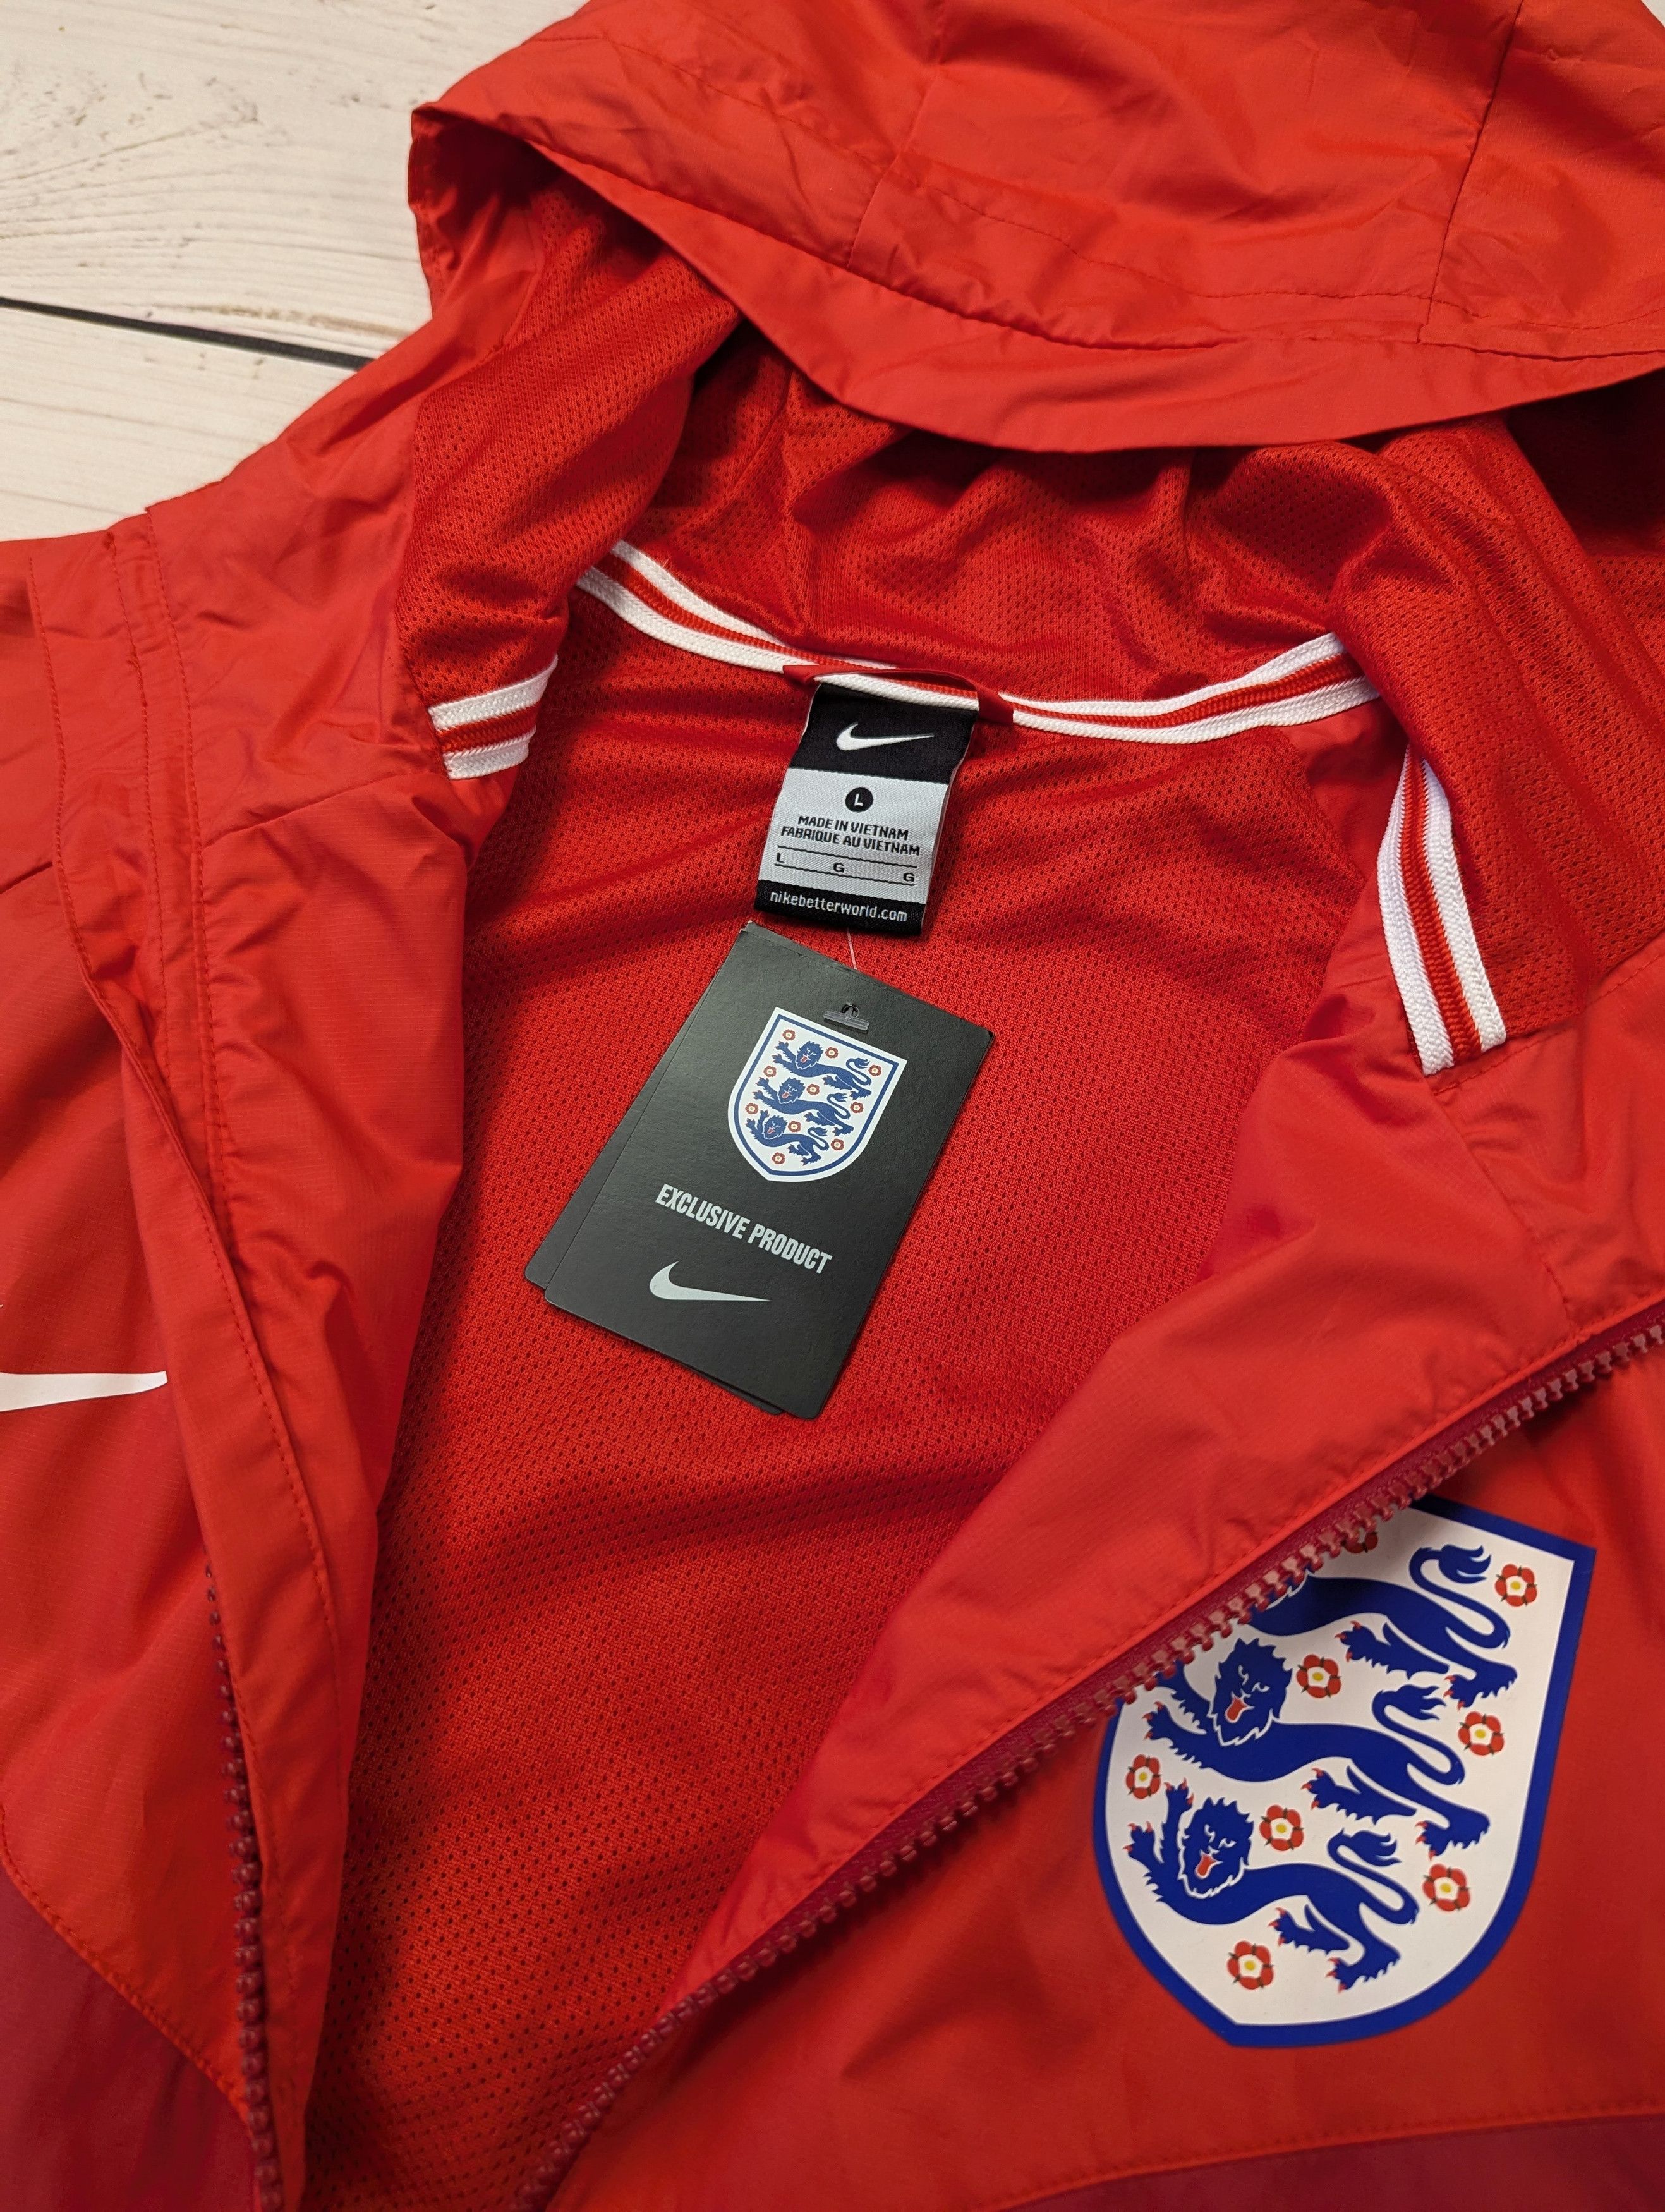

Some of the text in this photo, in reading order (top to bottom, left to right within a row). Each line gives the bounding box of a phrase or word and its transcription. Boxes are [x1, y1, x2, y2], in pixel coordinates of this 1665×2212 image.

[854, 793, 863, 806] L
[780, 826, 920, 856] FABRIQUE AU VIETNAM
[797, 815, 909, 841] MADE IN VIETNAM
[776, 853, 915, 882] L G G
[770, 891, 907, 922] nikebetterworld.com
[655, 1183, 833, 1274] EXCLUSIVE PRODUCT
